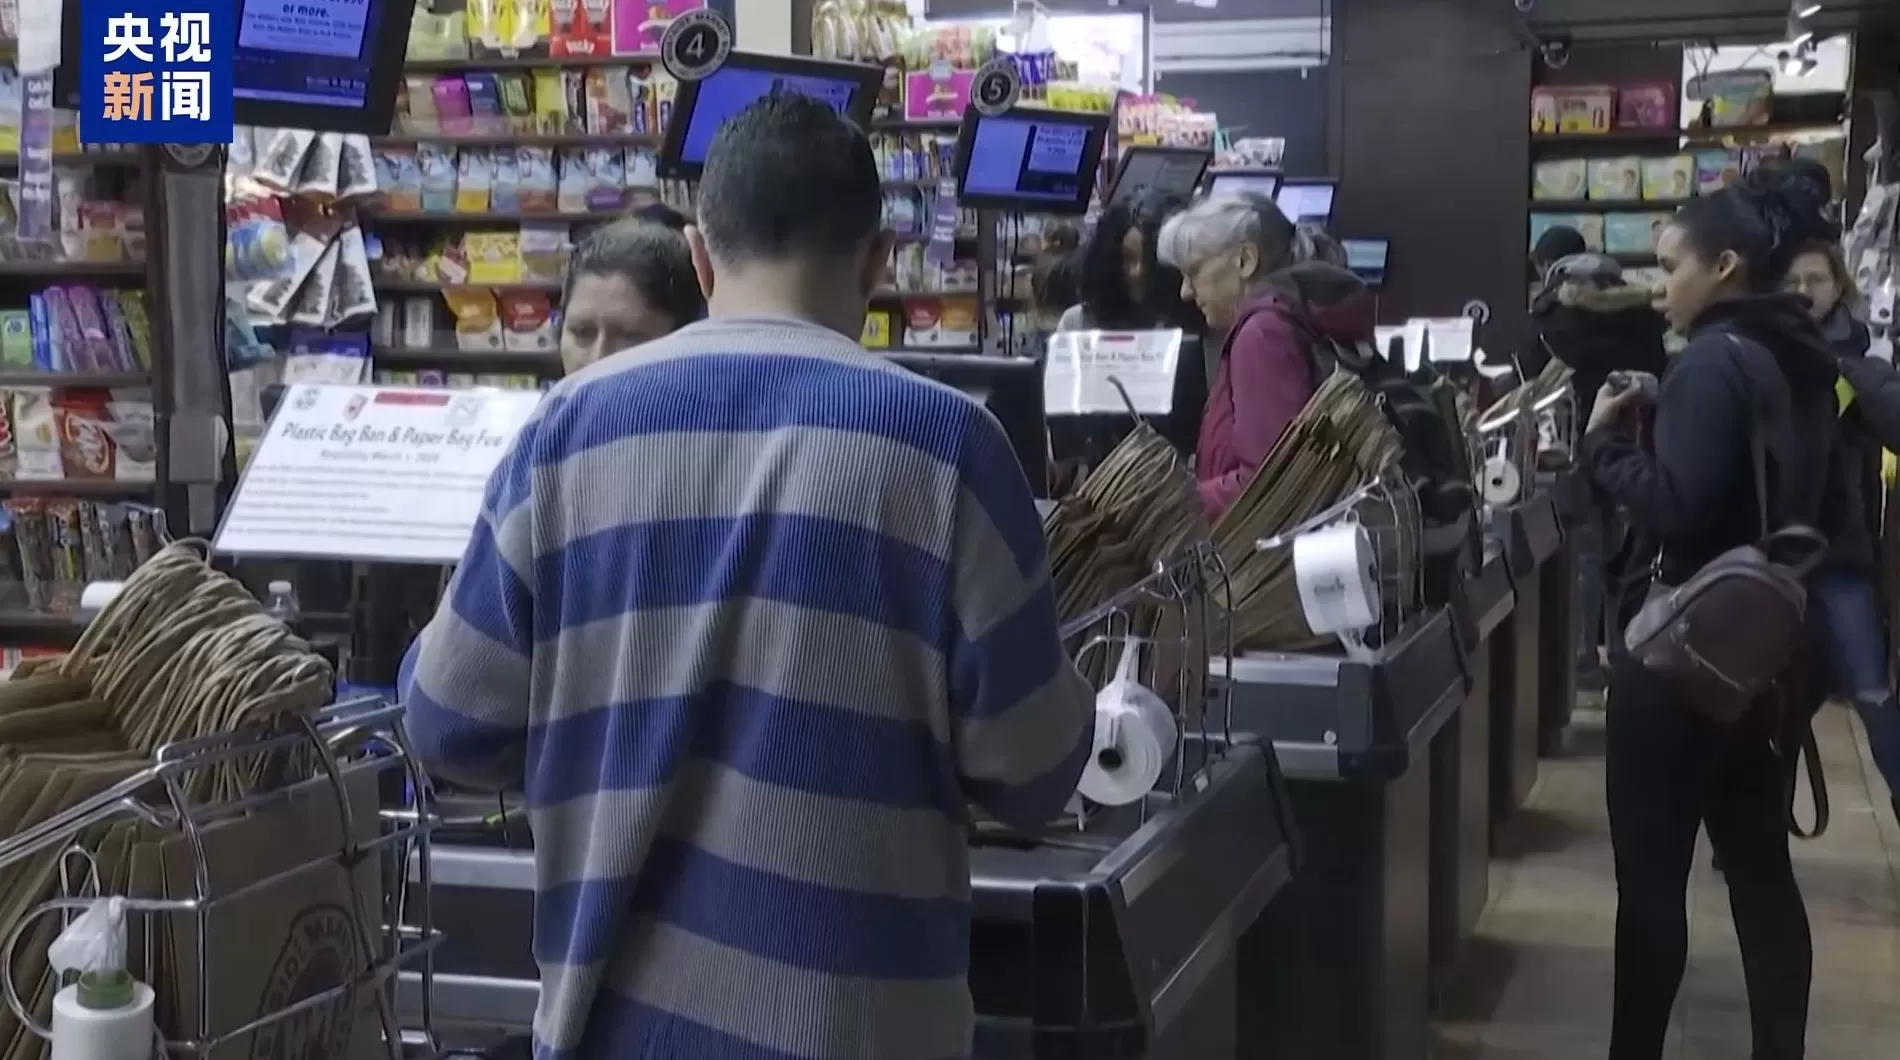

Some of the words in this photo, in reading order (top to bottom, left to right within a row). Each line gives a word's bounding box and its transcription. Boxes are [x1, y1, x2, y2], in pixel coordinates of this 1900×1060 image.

[282, 4, 294, 14] or
[297, 5, 330, 18] more.
[685, 32, 705, 59] 4
[988, 78, 1003, 100] 5
[281, 421, 328, 441] Plastic
[329, 423, 357, 446] Bag
[358, 424, 386, 443] Ban
[387, 425, 401, 444] &
[402, 426, 445, 447] Paper
[447, 428, 475, 451] Bag
